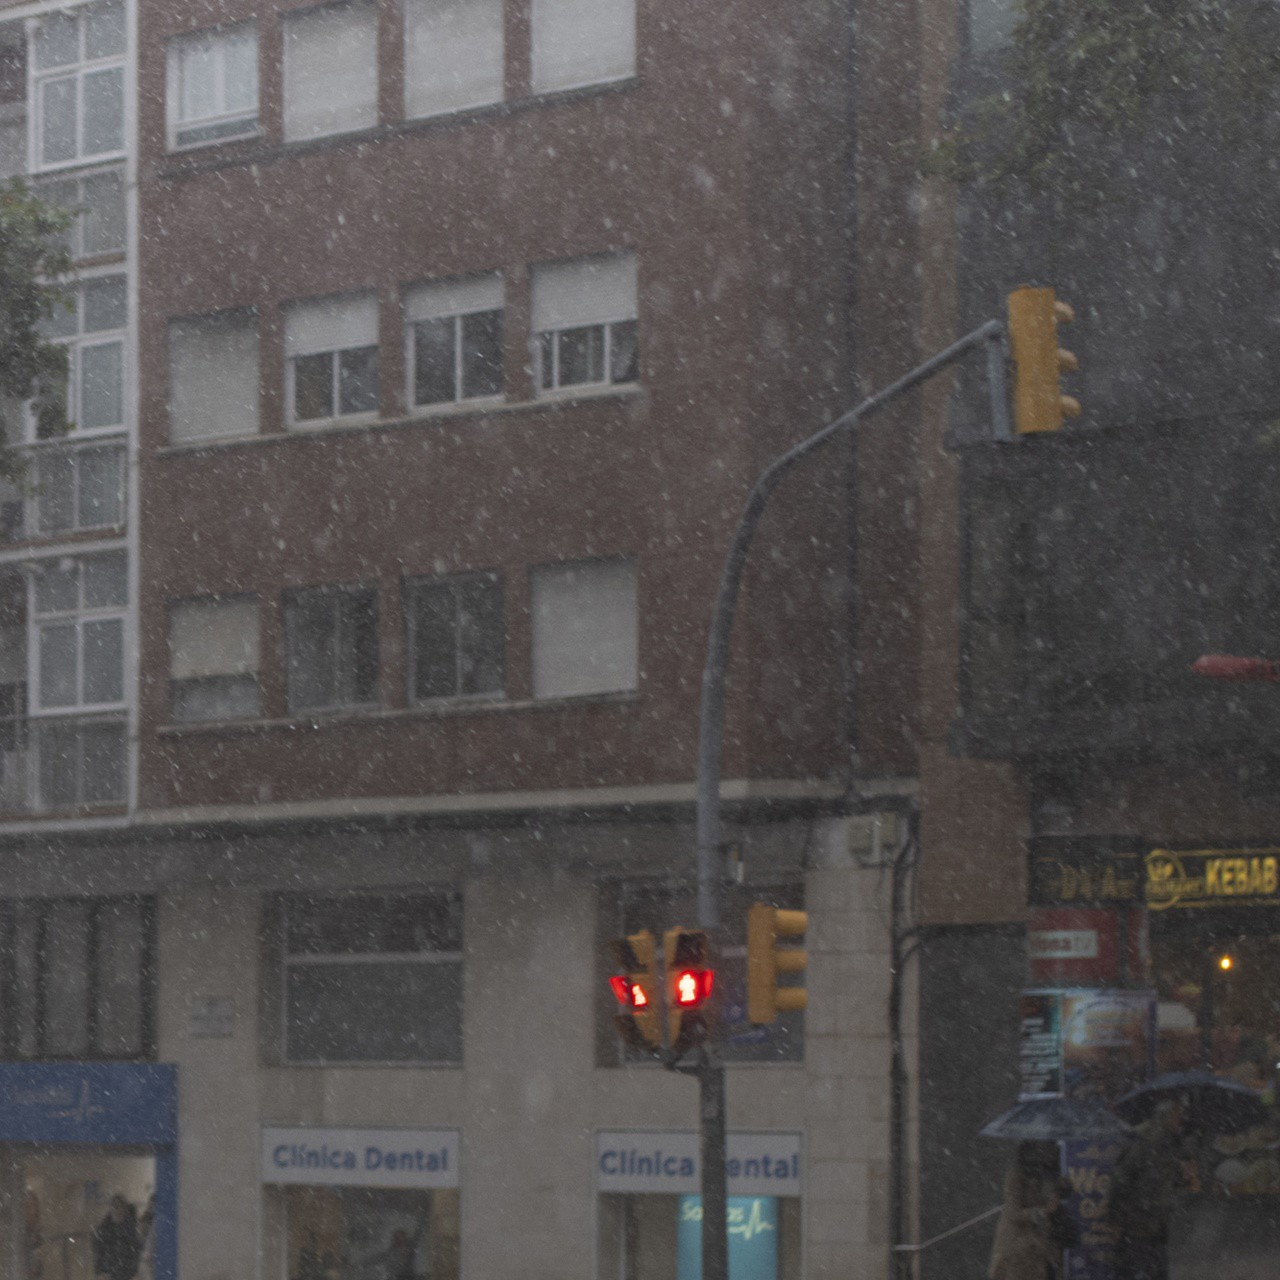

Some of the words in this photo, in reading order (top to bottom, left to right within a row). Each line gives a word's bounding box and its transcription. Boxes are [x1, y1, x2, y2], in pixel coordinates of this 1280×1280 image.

[1205, 857, 1278, 895] KEBAB
[273, 1144, 357, 1171] Clínica
[365, 1146, 448, 1172] Dental
[599, 1148, 695, 1178] Clínica
[726, 1153, 800, 1179] ental
